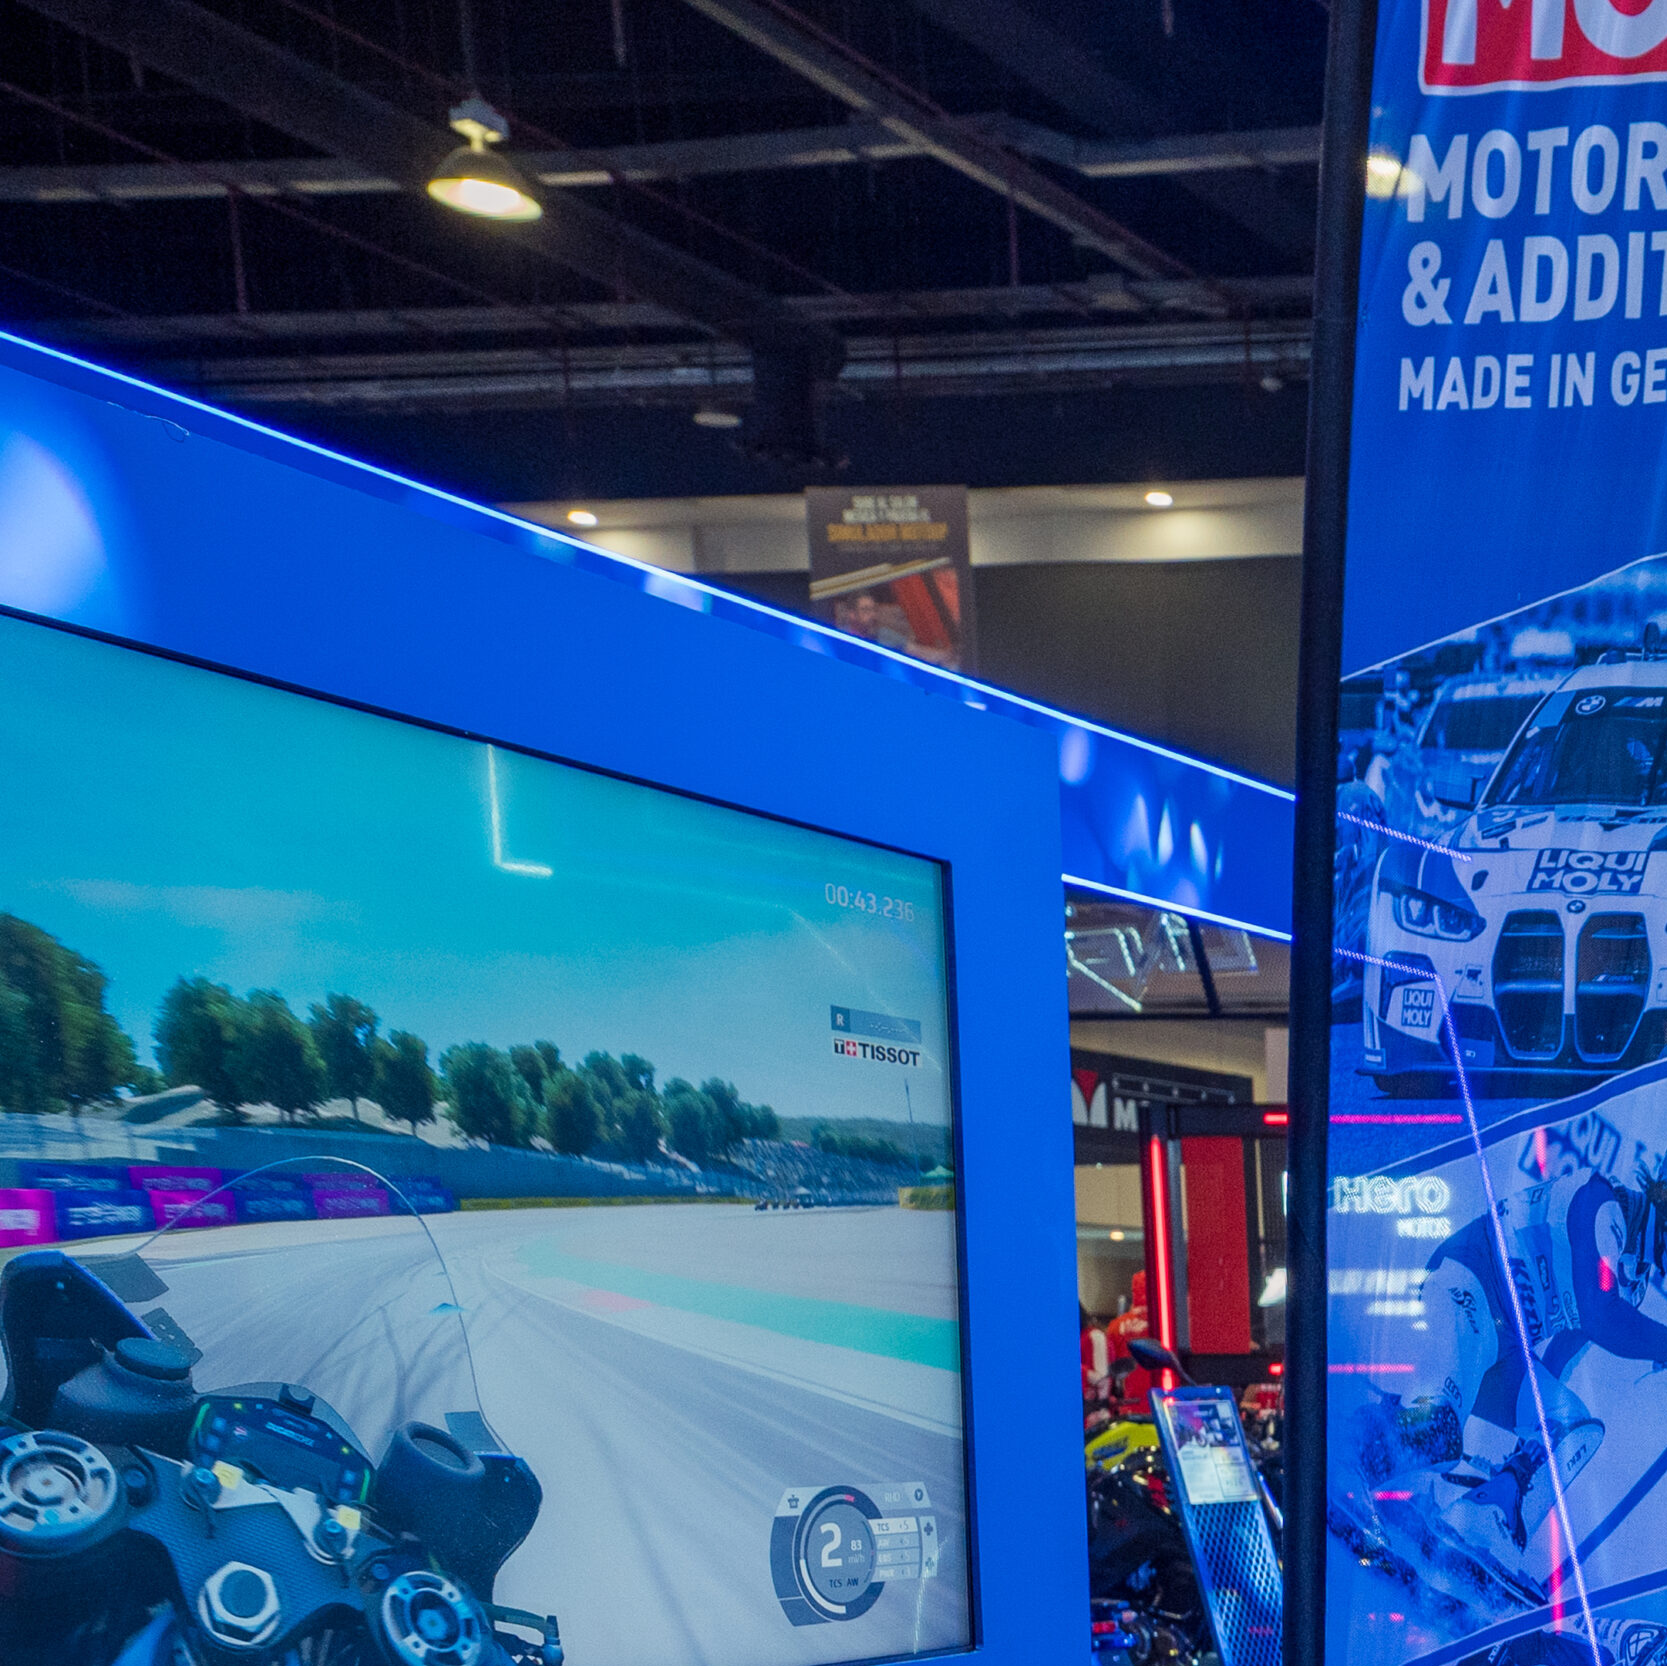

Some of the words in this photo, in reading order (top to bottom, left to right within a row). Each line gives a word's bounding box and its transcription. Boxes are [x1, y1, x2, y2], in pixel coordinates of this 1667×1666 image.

[1402, 240, 1455, 327] &
[1398, 353, 1533, 411] MADE
[1547, 351, 1596, 408] IN
[1538, 850, 1649, 870] LIQUI
[1532, 870, 1643, 893] MOLY
[824, 883, 915, 922] 00:43.236
[1401, 989, 1435, 1007] LIQUI
[1401, 1008, 1433, 1027] MOLY
[858, 1042, 920, 1066] TISSOT
[877, 1522, 889, 1532] TCS
[820, 1522, 843, 1568] 2
[851, 1539, 862, 1551] 83
[829, 1578, 843, 1588] TCS
